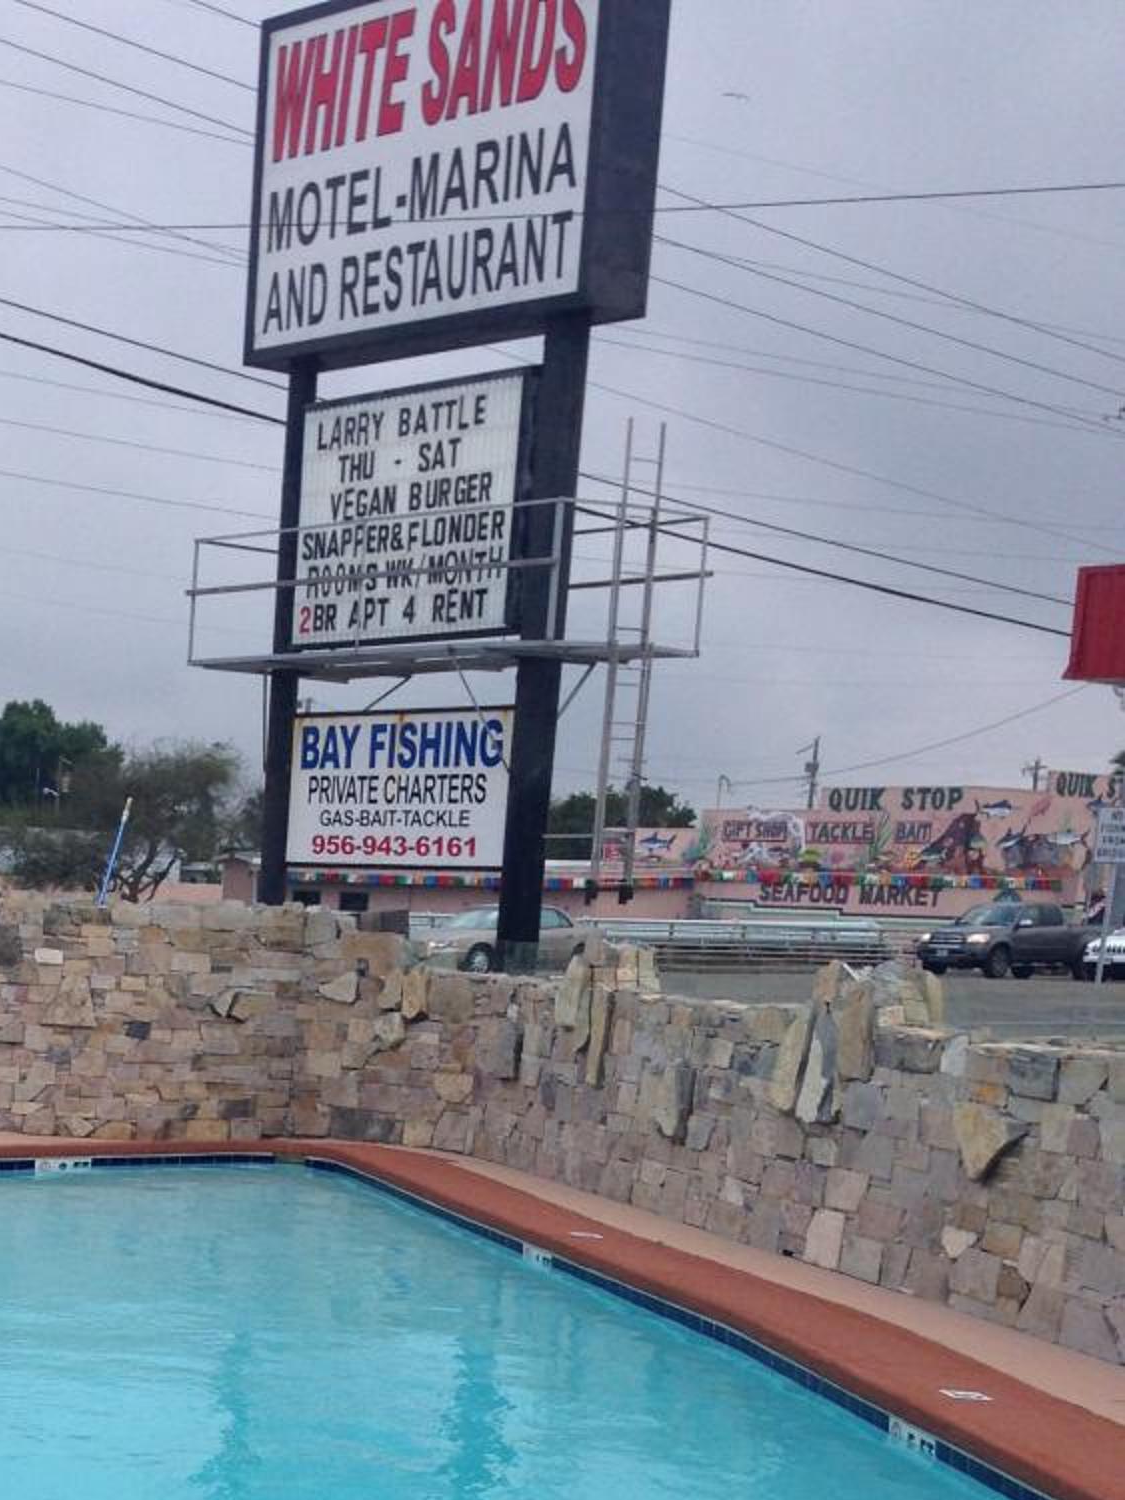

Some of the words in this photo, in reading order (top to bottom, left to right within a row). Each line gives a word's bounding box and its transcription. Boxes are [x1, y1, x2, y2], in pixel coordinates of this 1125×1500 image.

[273, 9, 416, 162] WHITE
[421, 0, 587, 126] SANDS
[267, 122, 576, 254] MOTEL-MARINA
[262, 262, 328, 335] AND
[339, 210, 573, 320] RESTAURANT
[317, 411, 384, 451] LARRY
[398, 395, 486, 437] BATTLE
[338, 451, 375, 483] THU
[418, 438, 462, 472] SAT
[331, 485, 397, 521] VEGAN
[408, 472, 492, 511] BURGER
[299, 604, 338, 634] 2BR
[348, 597, 390, 632] APT
[403, 596, 416, 624] 4
[432, 588, 488, 623] RENT
[301, 725, 361, 770] BAY
[369, 719, 504, 769] FISHING
[308, 775, 379, 804] PRIVATE
[384, 773, 488, 804] CHARTERS
[828, 787, 886, 812] QUIK
[902, 787, 964, 811] STOP
[312, 834, 477, 857] 956-943-6161
[807, 823, 875, 844] TACKLE
[759, 884, 849, 904] SEAFOOD
[859, 885, 943, 908] MARKET
